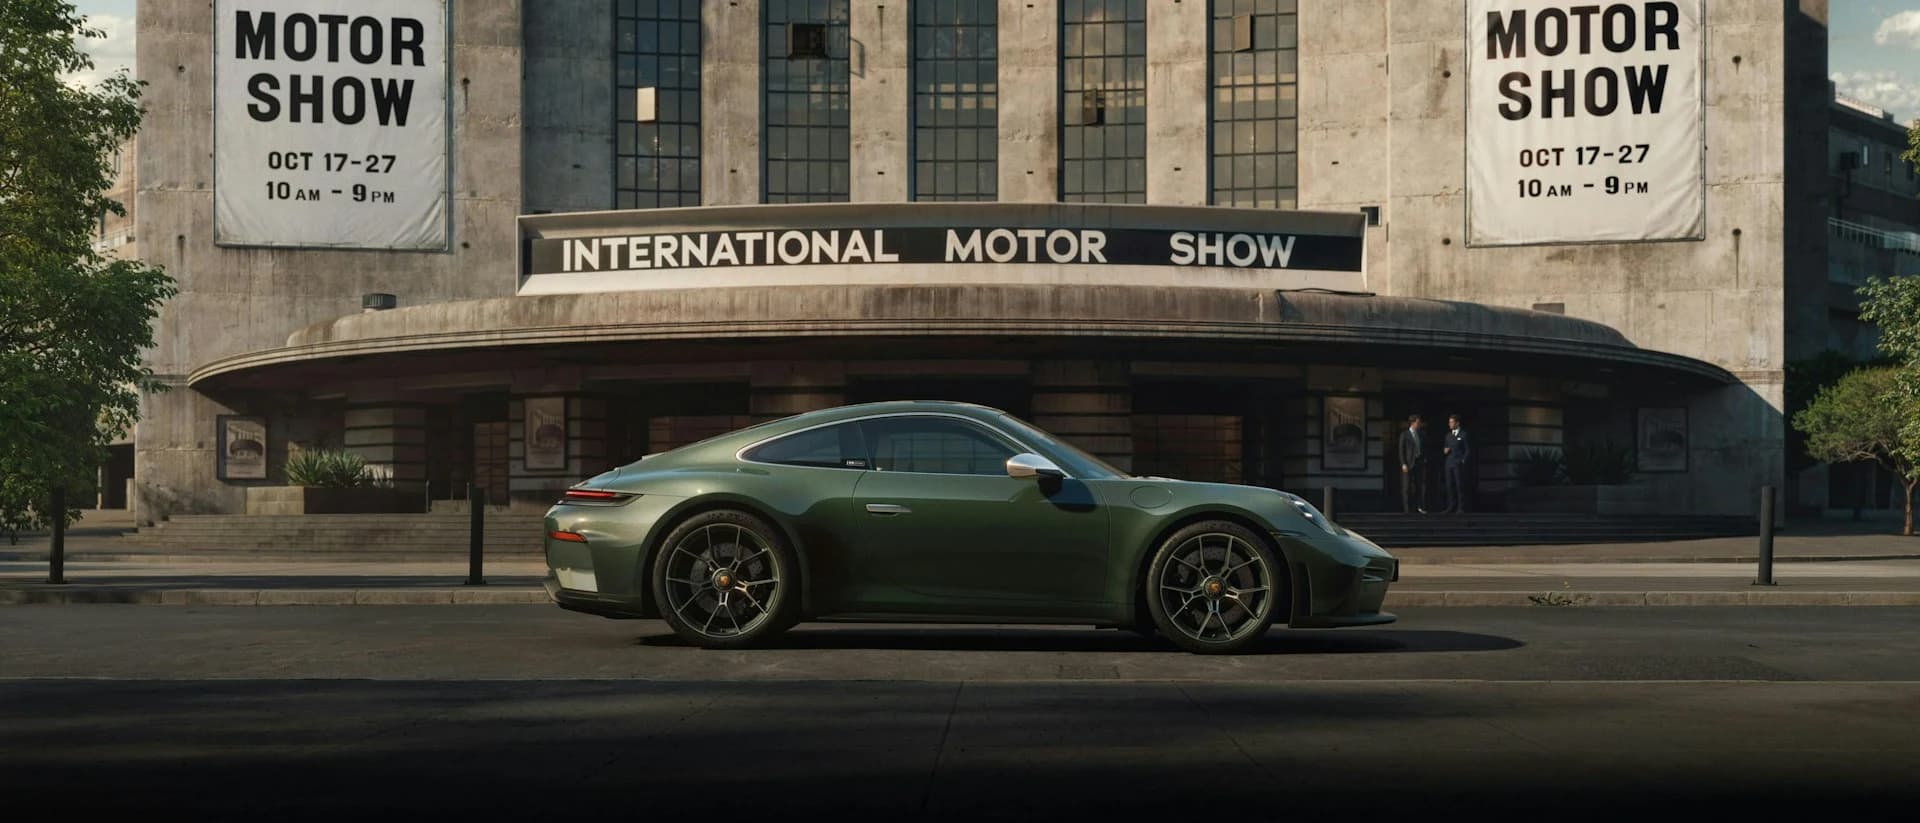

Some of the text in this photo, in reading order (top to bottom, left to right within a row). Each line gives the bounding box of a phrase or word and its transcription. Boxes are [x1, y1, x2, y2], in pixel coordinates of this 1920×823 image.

[235, 10, 426, 67] MOTOR
[1486, 1, 1681, 60] MOTOR
[247, 72, 415, 127] SHOW
[1498, 64, 1669, 121] SHOW
[268, 151, 397, 174] OCT 17-27
[1519, 143, 1650, 168] OCT 17-27
[562, 228, 1297, 272] INTERNATIONAL MOTOR SHOW
